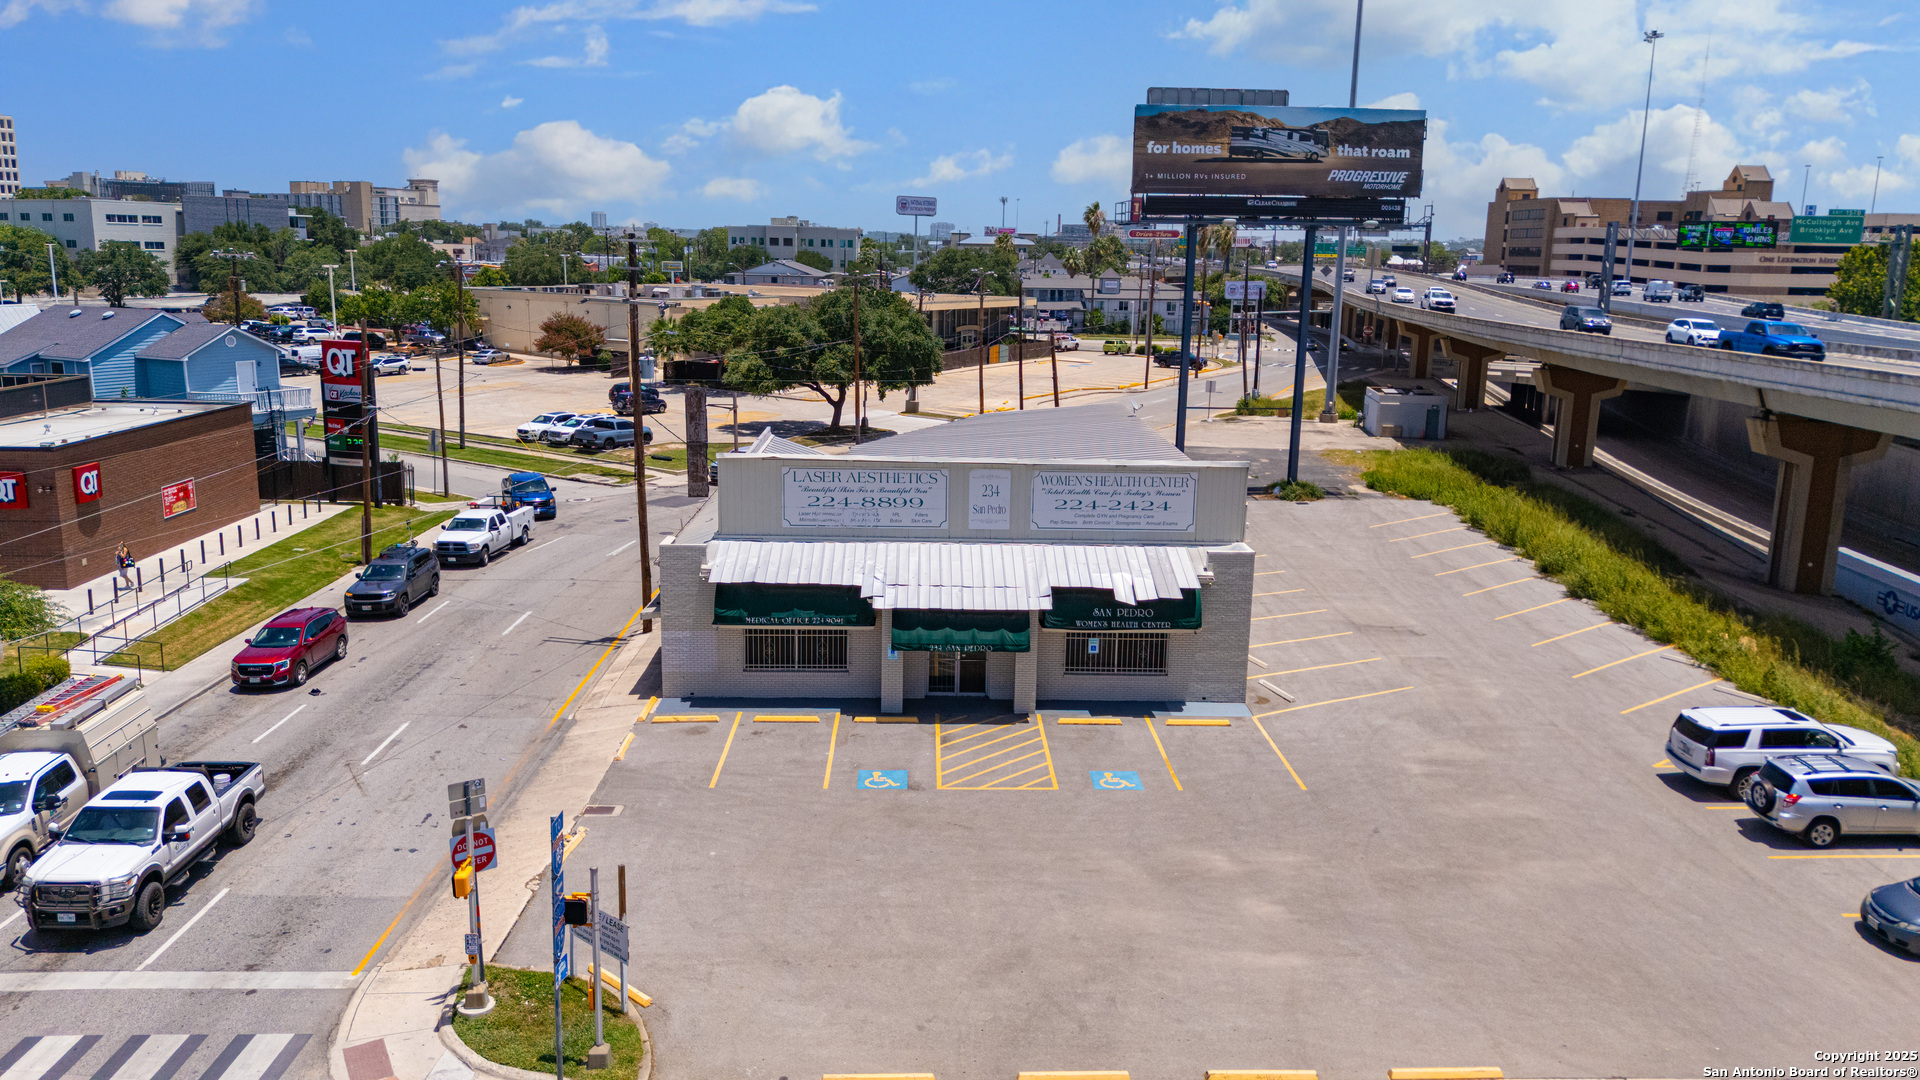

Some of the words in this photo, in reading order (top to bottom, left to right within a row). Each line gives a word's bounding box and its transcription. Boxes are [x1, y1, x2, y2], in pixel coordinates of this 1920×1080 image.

[1147, 141, 1169, 154] for
[1172, 141, 1222, 154] homes
[1337, 144, 1368, 157] that
[1372, 148, 1411, 158] roam
[1327, 169, 1409, 184] PROGRESSIVE
[1362, 183, 1403, 191] MOTORHOME
[326, 347, 356, 377] QT
[80, 470, 98, 495] QT
[793, 471, 842, 483] LASER
[846, 471, 938, 484] AESTHETICS
[1040, 475, 1093, 487] WOMEN'S
[1095, 476, 1141, 488] HEALTH
[1143, 476, 1189, 488] CENTER
[876, 487, 912, 496] Beautiful
[981, 483, 1000, 497] 234
[1067, 488, 1091, 496] Health
[1110, 489, 1122, 498] for
[1123, 489, 1151, 498] Today's
[807, 495, 924, 509] 224-8899
[1054, 499, 1172, 511] 224-2424
[972, 504, 986, 515] San
[987, 504, 1007, 515] Pedro
[1092, 607, 1112, 617] SAN
[1116, 608, 1154, 618] PEDRO
[1111, 620, 1139, 628] HEALTH
[1141, 621, 1171, 629] CENTER
[945, 644, 960, 652] SAN
[474, 837, 488, 847] NOT
[605, 917, 625, 934] LEASE
